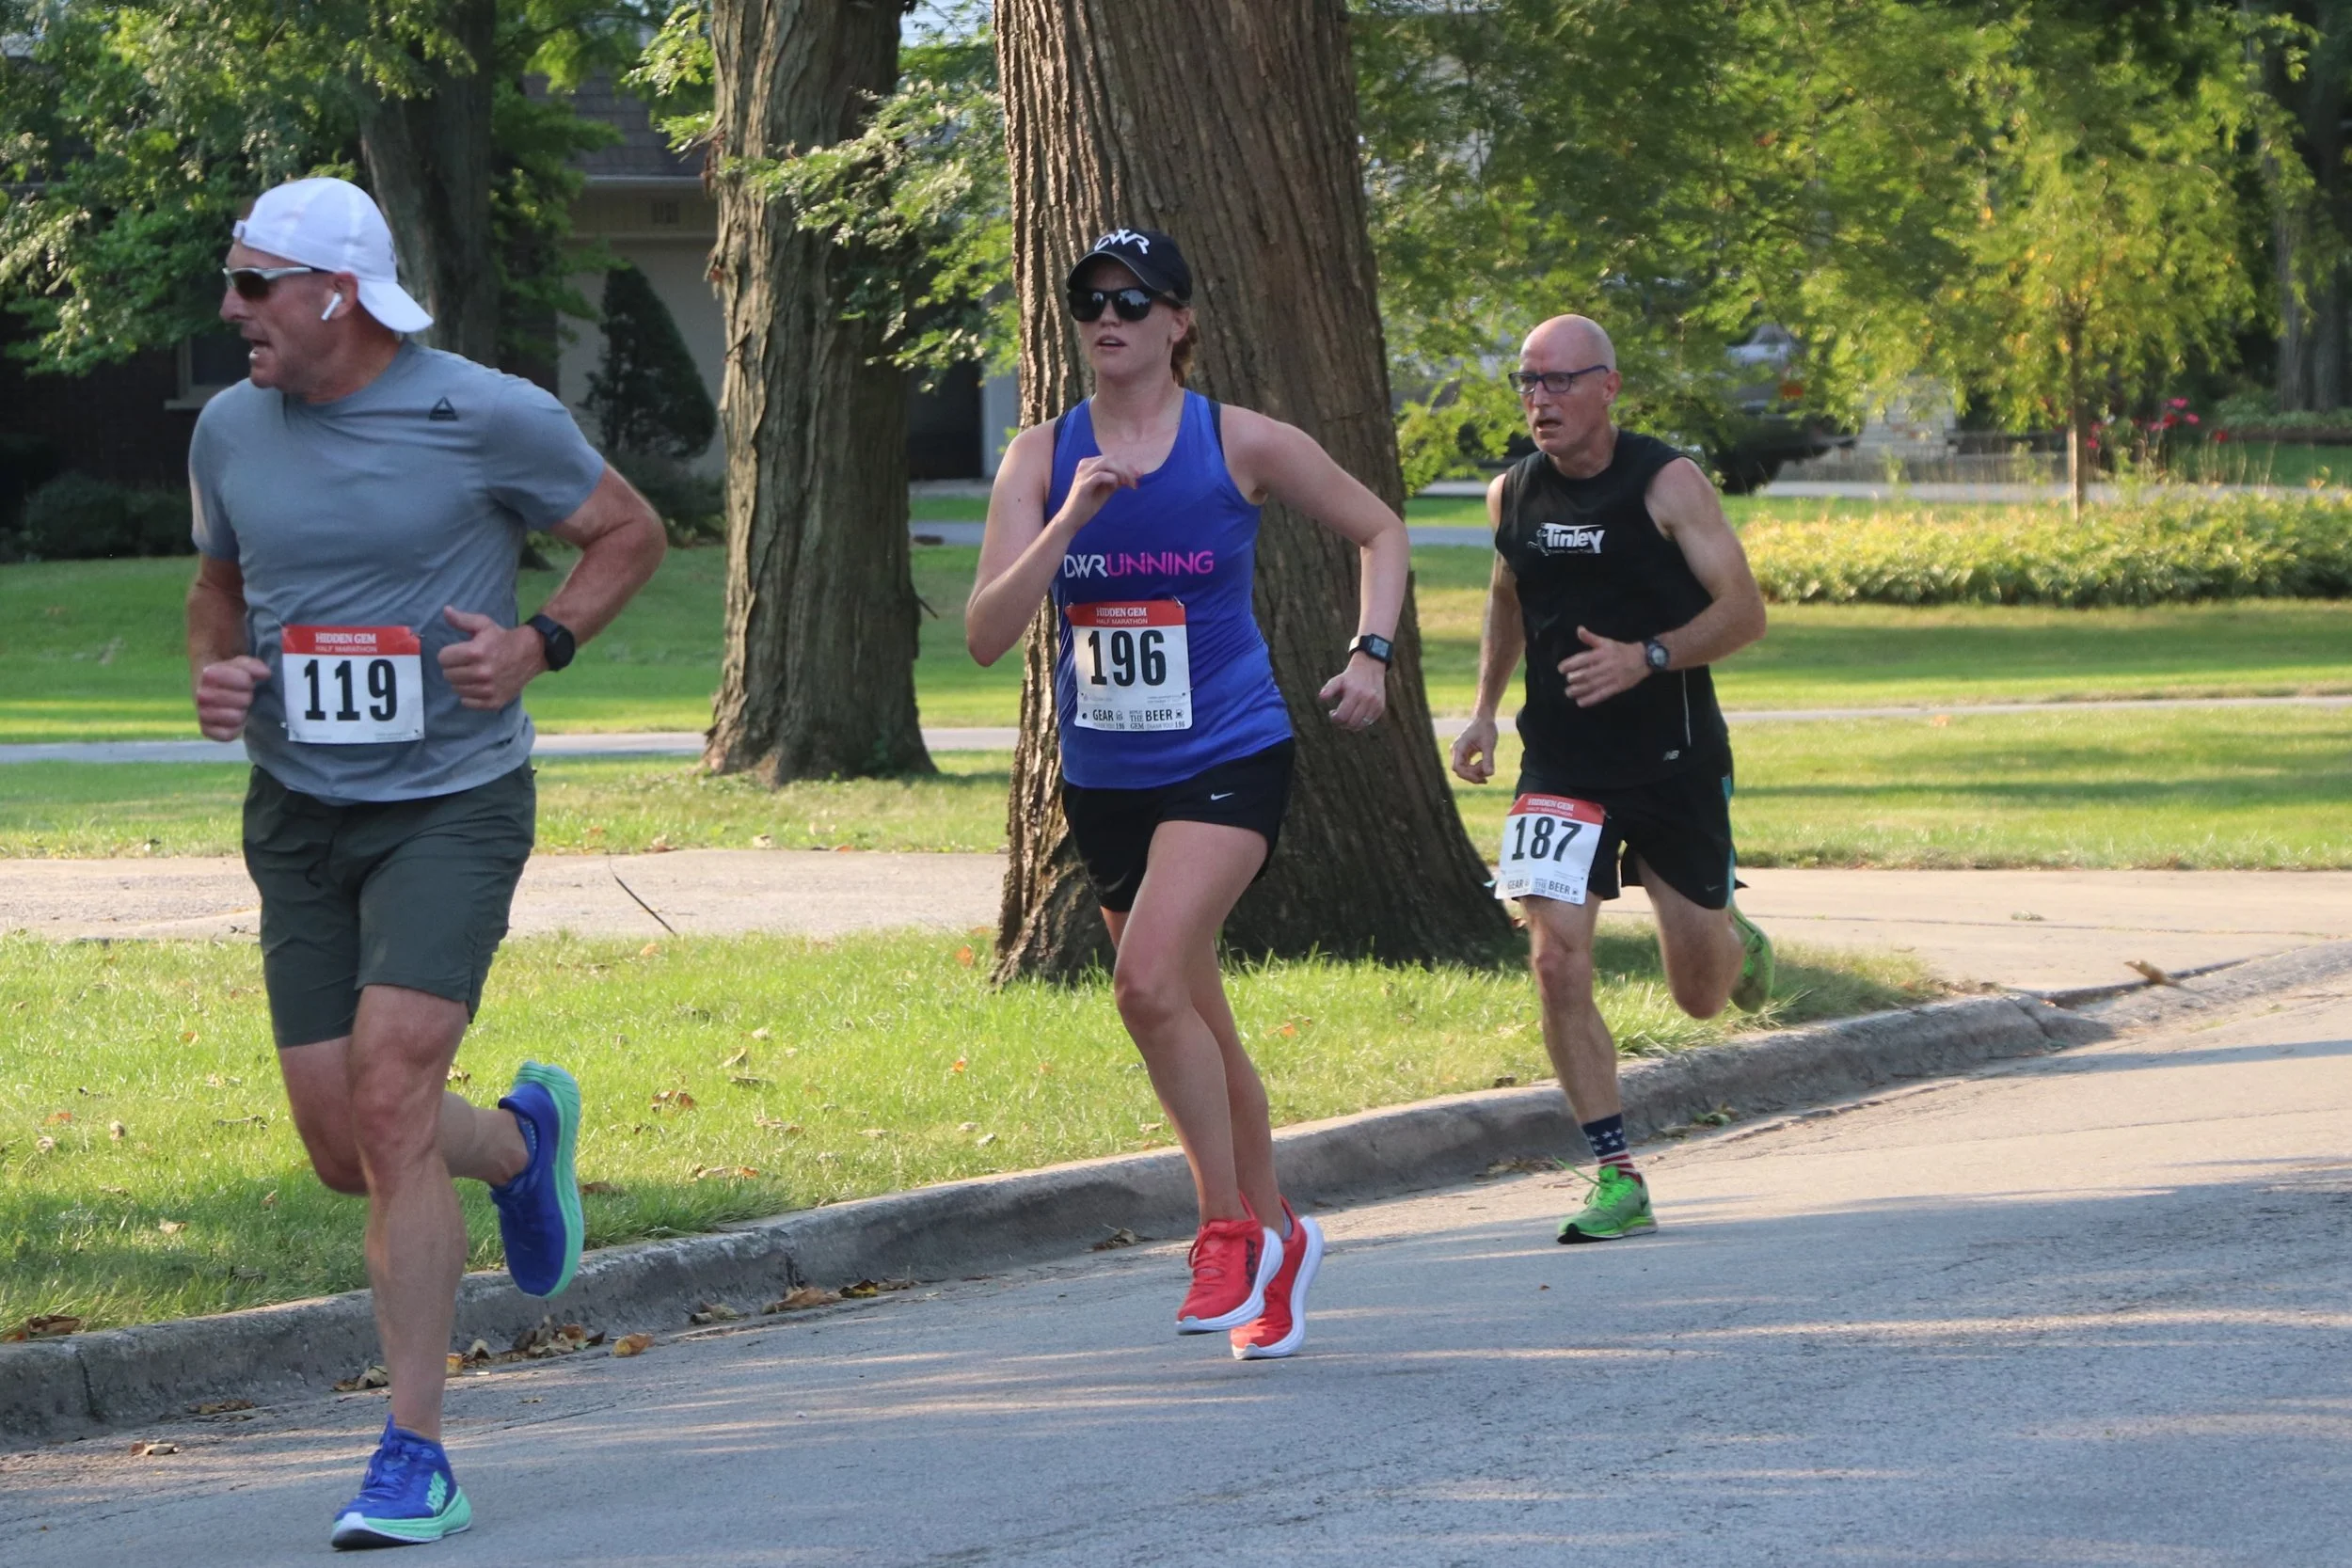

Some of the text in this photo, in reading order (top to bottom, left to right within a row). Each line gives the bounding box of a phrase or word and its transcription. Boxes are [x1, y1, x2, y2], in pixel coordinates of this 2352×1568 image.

[1541, 522, 1605, 554] Tinley
[1096, 607, 1147, 617] HIDDEN GEM
[315, 632, 376, 644] HIDDEN GEM
[1089, 629, 1167, 687] 196
[304, 658, 397, 721] 119
[1092, 708, 1173, 721] GEAR BEER
[1557, 801, 1574, 812] GEM
[1512, 816, 1582, 862] 187
[1549, 880, 1570, 895] BEER
